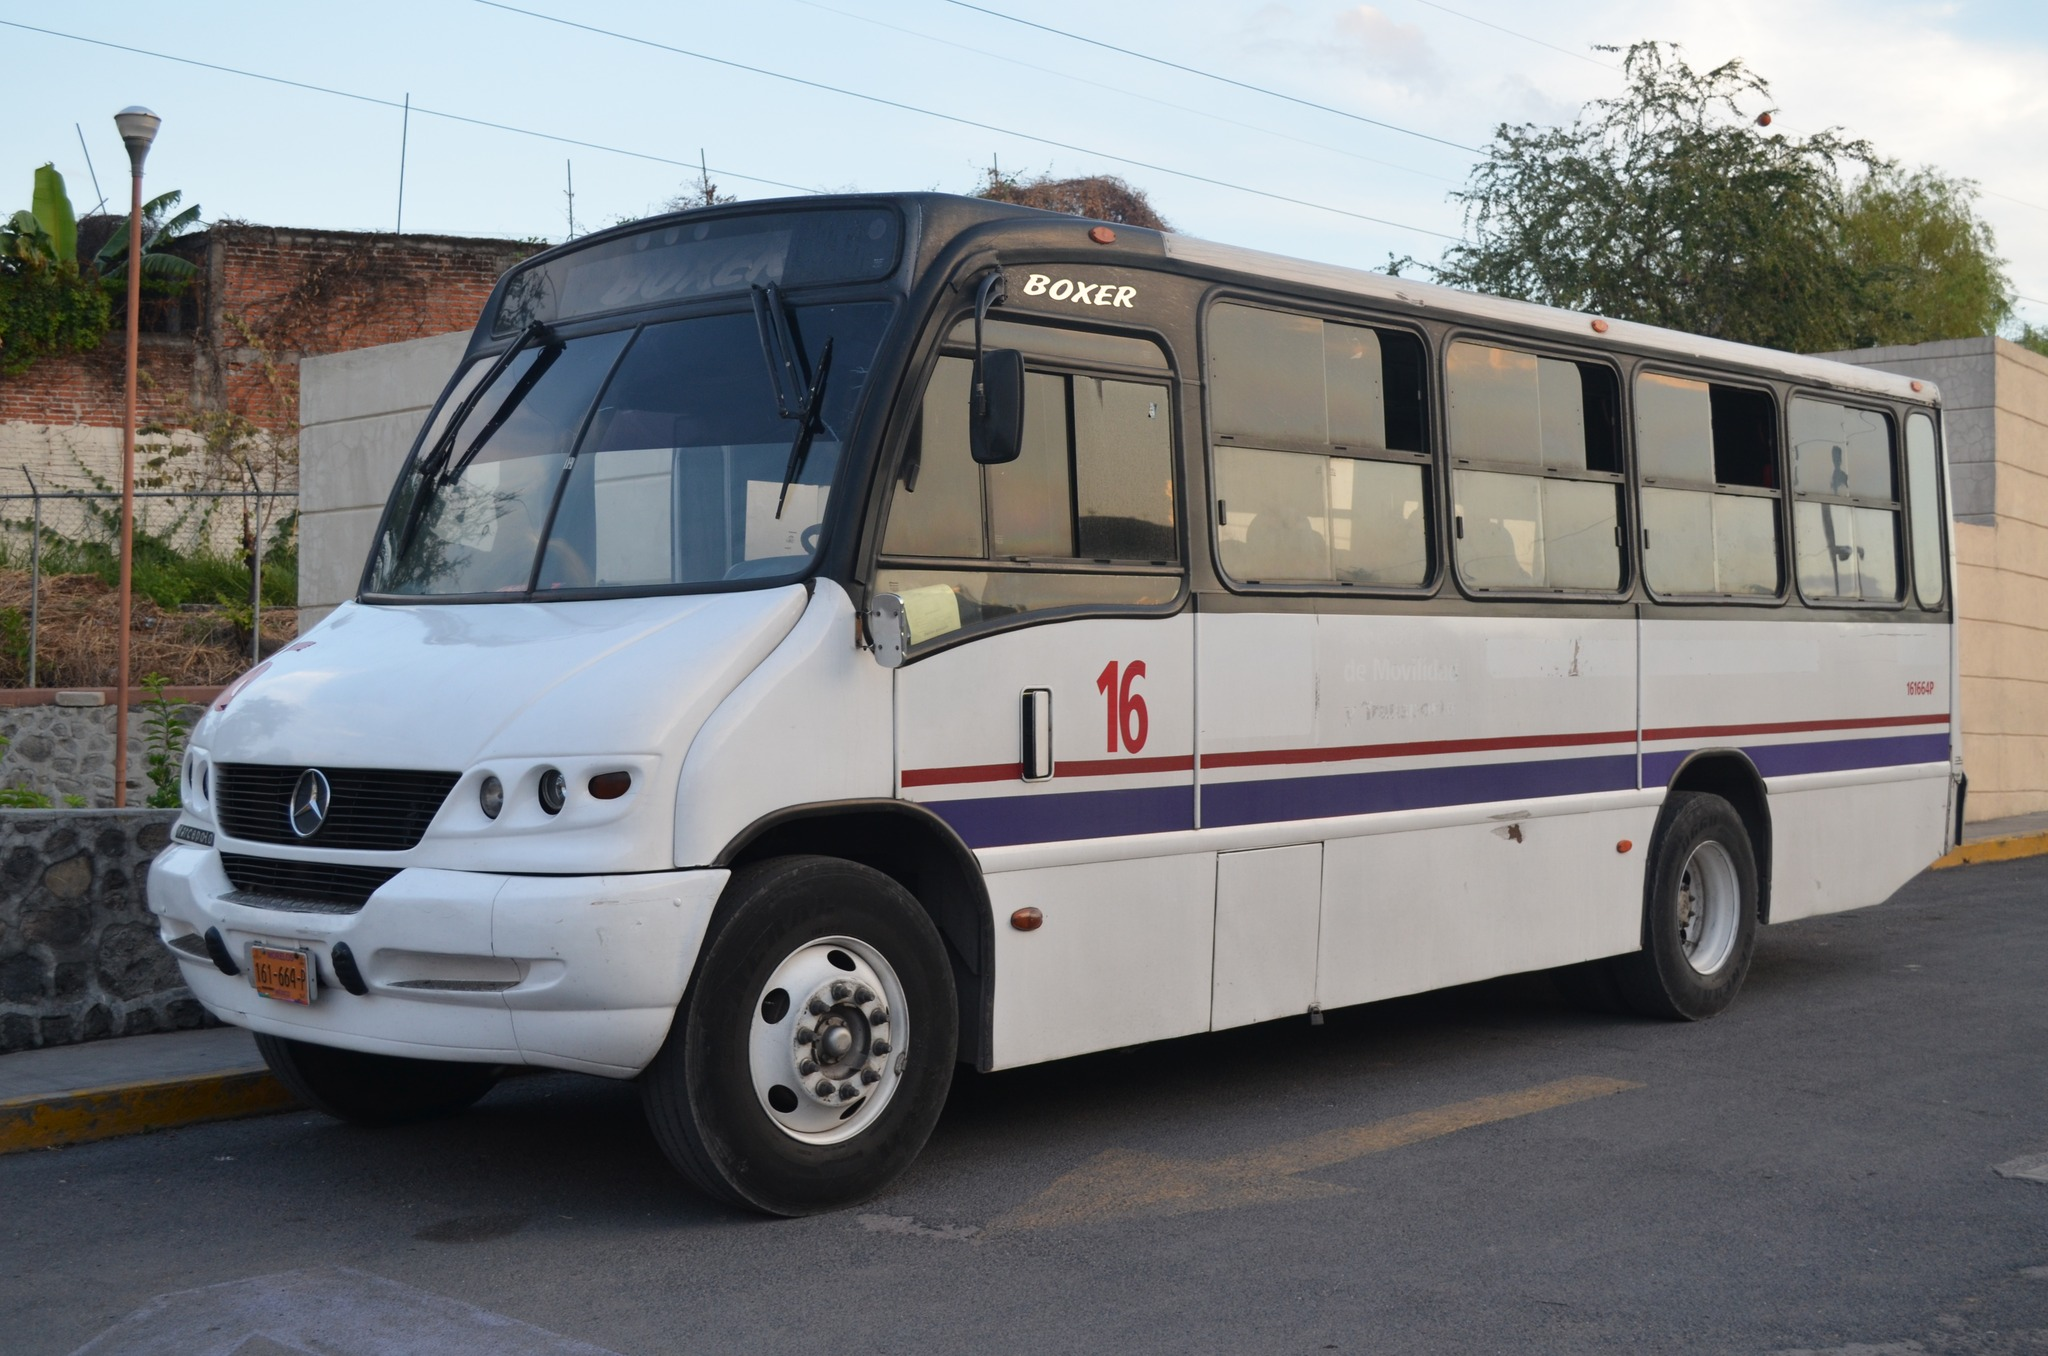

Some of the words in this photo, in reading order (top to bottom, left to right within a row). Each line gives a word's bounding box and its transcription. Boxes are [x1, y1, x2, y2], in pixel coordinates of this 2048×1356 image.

[1023, 273, 1137, 308] BOXER
[1343, 656, 1368, 680] de
[1906, 680, 1935, 696] 161664P
[1096, 659, 1149, 754] 16
[255, 962, 306, 990] 161-664-P
